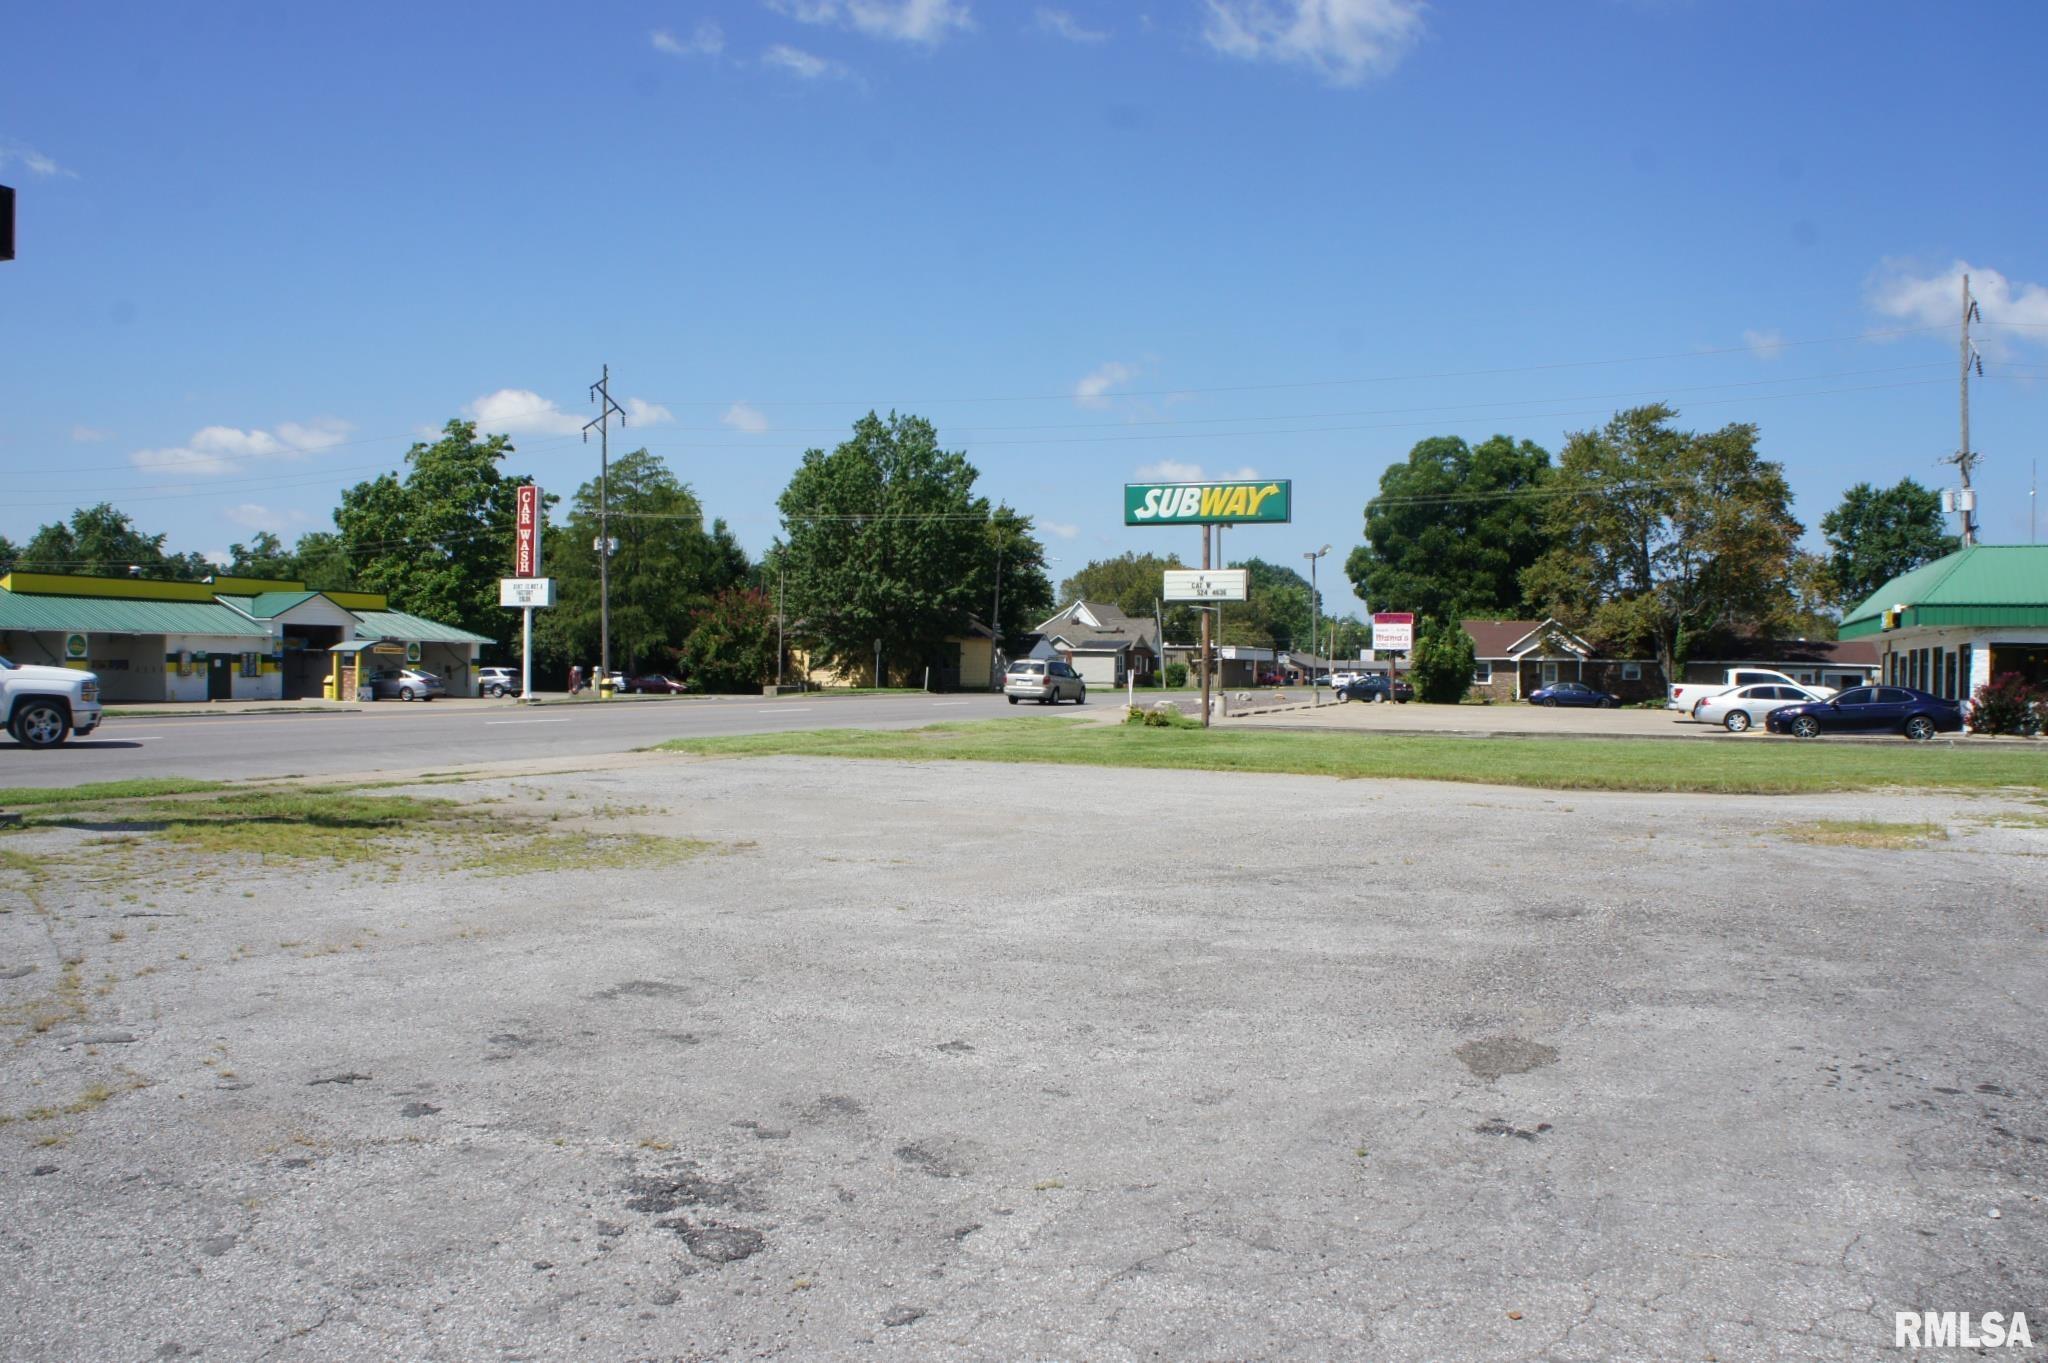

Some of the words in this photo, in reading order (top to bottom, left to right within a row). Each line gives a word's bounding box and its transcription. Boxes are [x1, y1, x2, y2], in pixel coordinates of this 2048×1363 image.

[521, 491, 531, 525] CAR
[1134, 484, 1280, 520] SUBWAY
[519, 529, 531, 573] WASH
